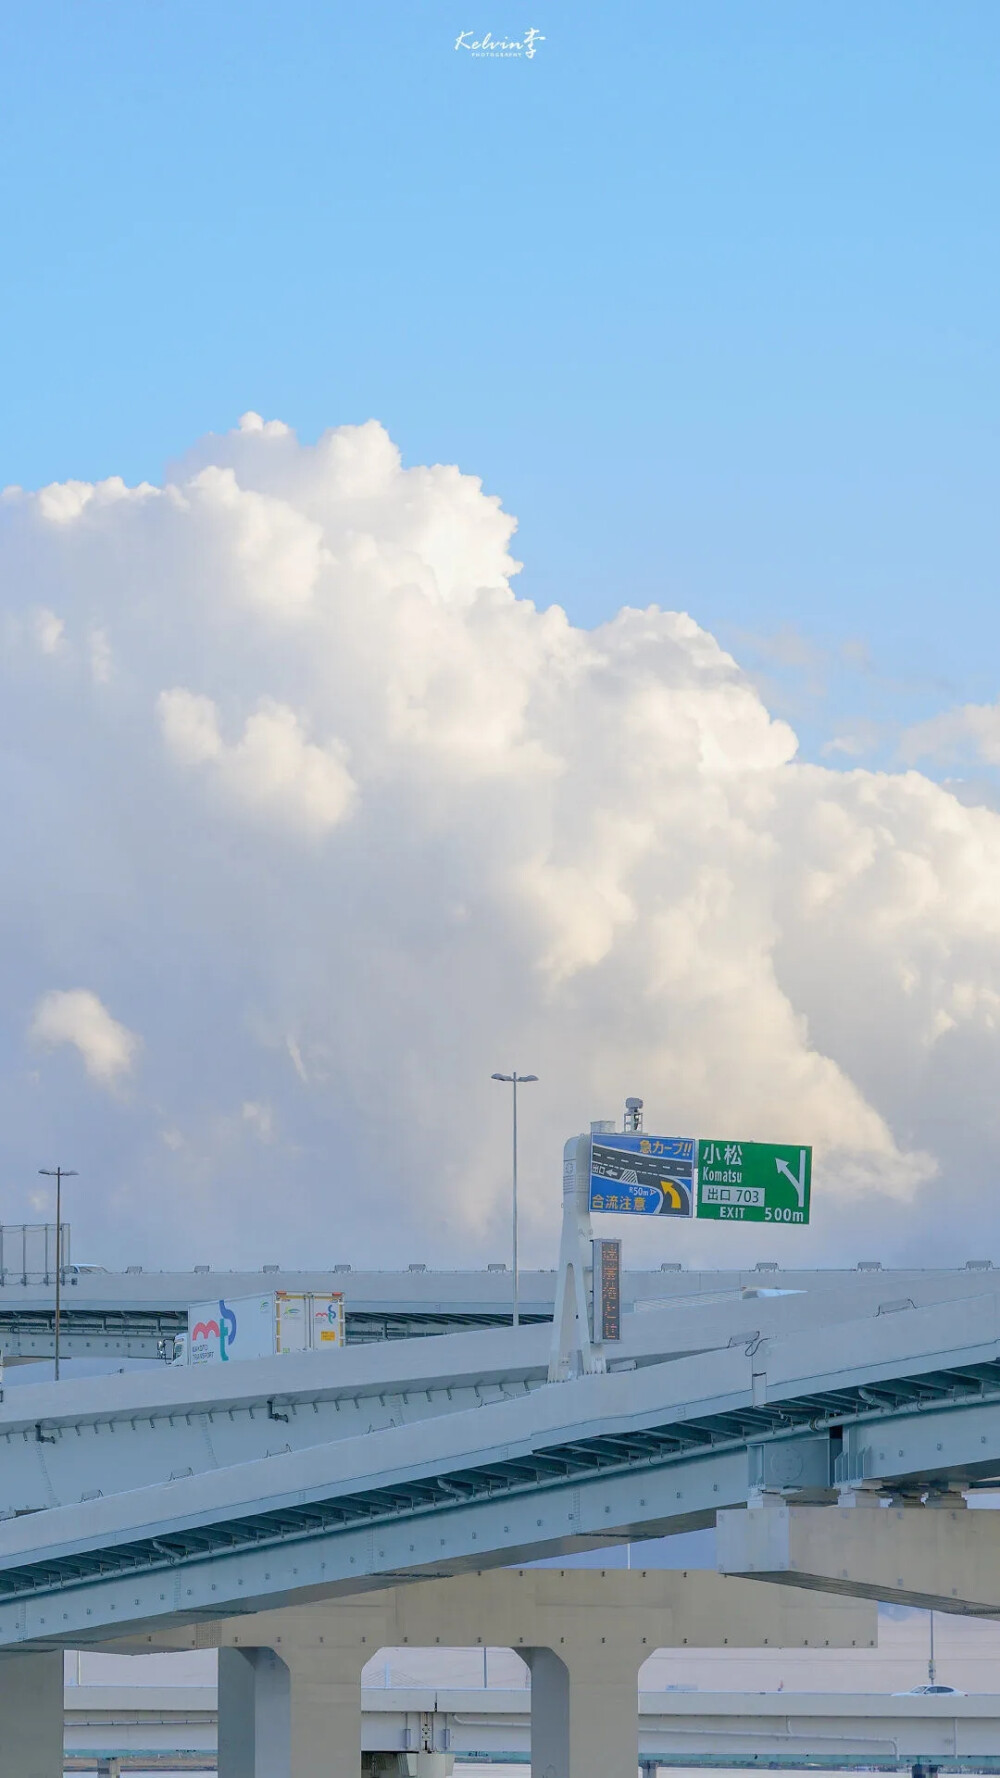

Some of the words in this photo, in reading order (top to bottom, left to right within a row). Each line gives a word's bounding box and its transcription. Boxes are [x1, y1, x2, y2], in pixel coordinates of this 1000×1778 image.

[703, 1143, 743, 1166] 小松
[592, 1164, 606, 1175] 出口
[702, 1166, 743, 1183] Komatsu
[592, 1194, 646, 1211] 合流注意
[707, 1188, 731, 1201] 出口
[736, 1189, 759, 1203] 703
[719, 1206, 745, 1219] EXIT
[764, 1207, 804, 1222] 500m
